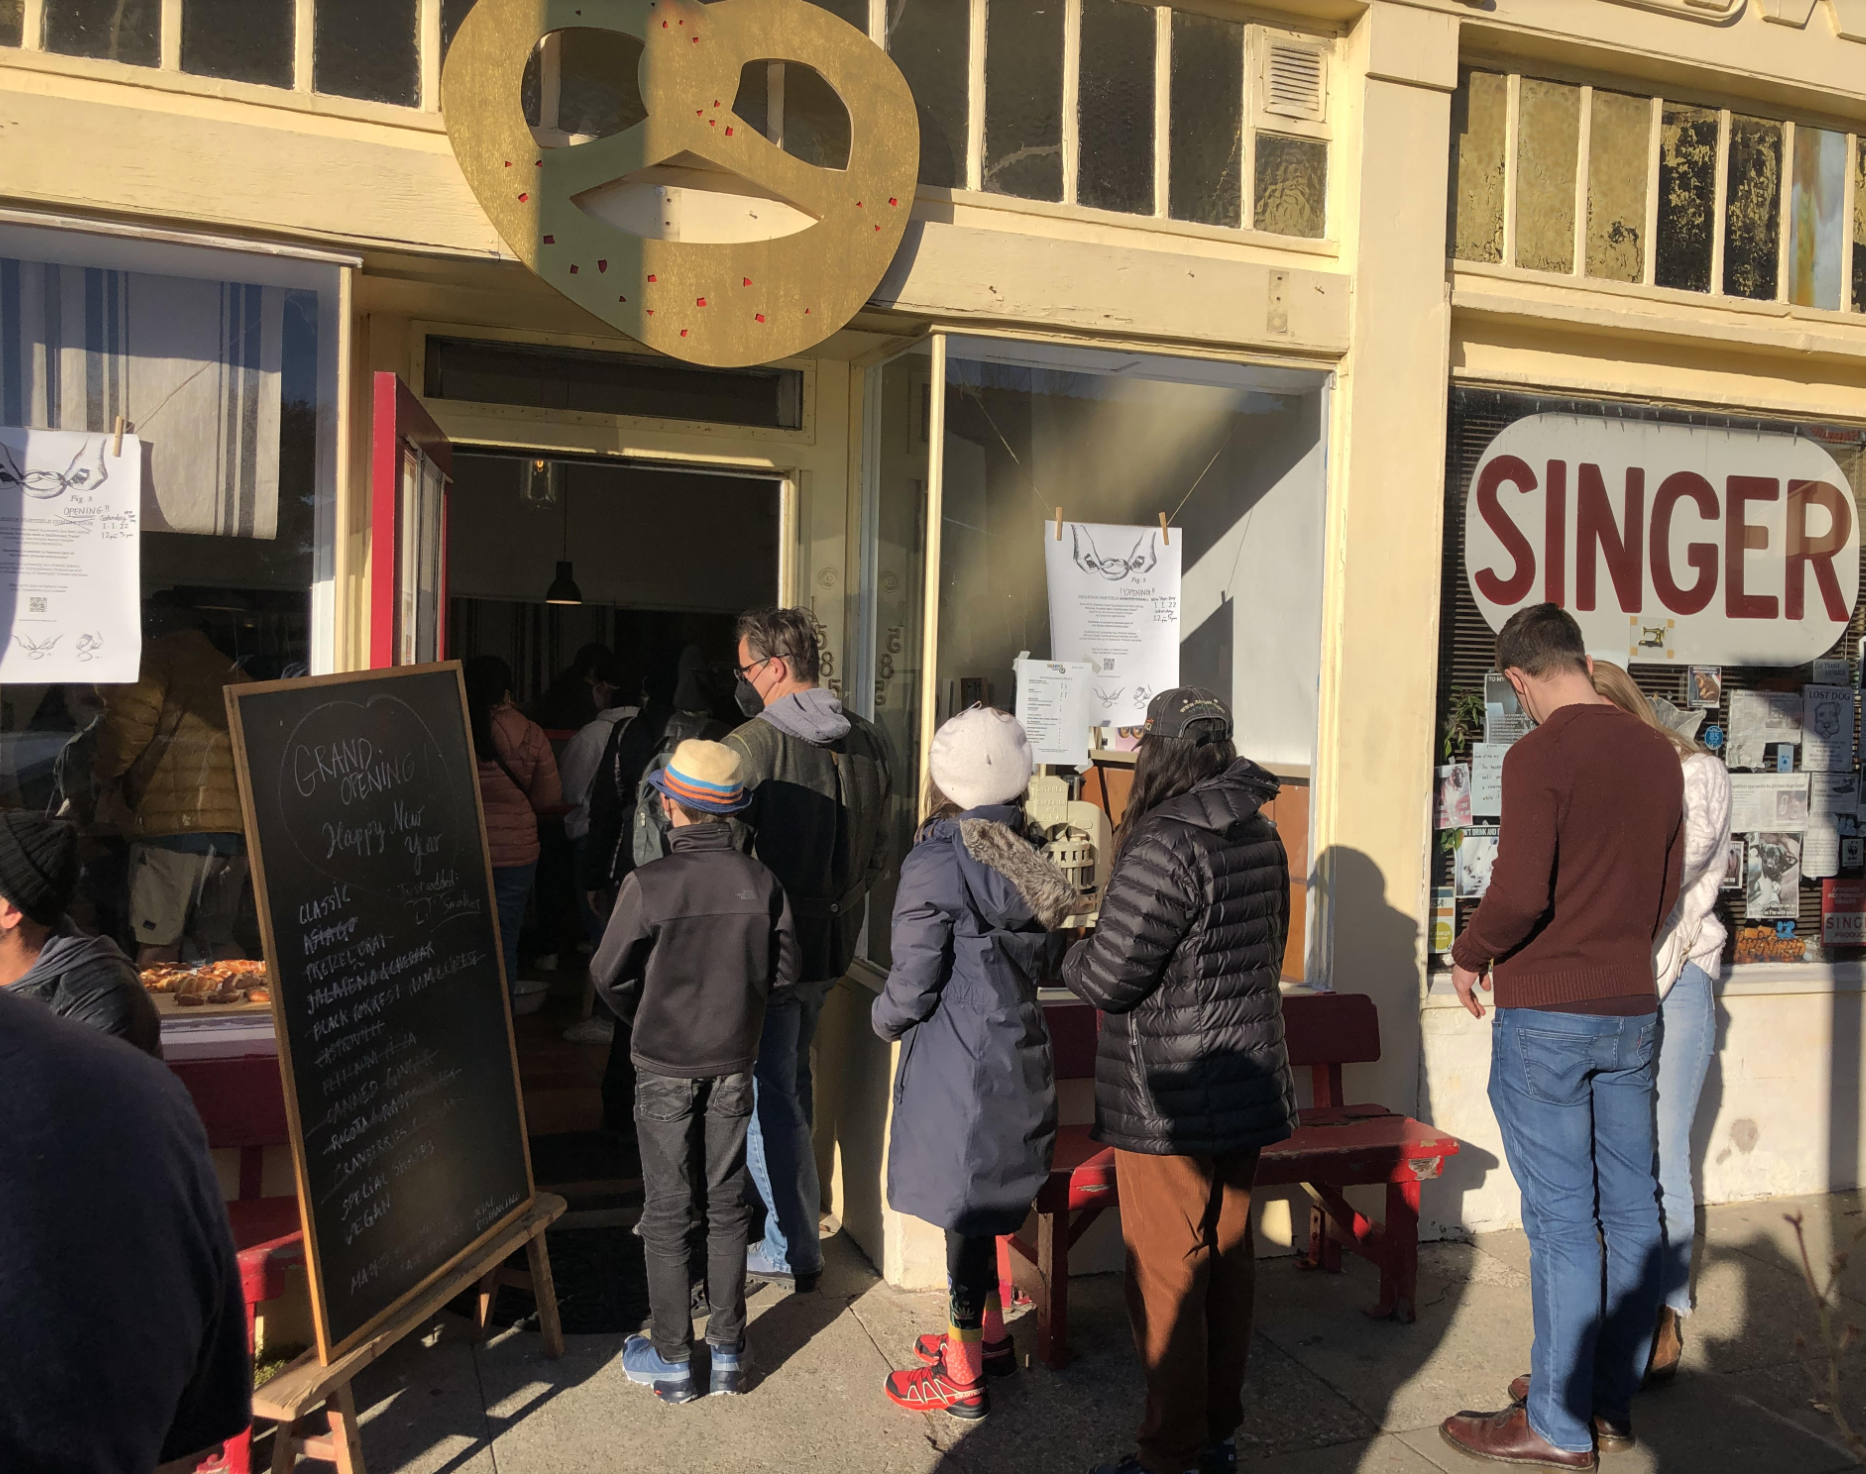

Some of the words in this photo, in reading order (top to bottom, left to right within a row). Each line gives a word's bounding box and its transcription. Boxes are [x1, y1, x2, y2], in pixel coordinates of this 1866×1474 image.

[1474, 453, 1852, 622] SINGER
[1809, 691, 1830, 699] LOST
[1831, 691, 1851, 700] DOG
[1709, 732, 1719, 741] 85
[294, 737, 373, 797] GRAND
[322, 820, 386, 859] Happy
[390, 800, 426, 835] New
[1471, 828, 1487, 836] DRINK
[1487, 828, 1497, 836] AND
[404, 832, 444, 875] Year
[299, 883, 351, 925] CLASSIC
[303, 916, 359, 955] ASIAGO
[306, 950, 356, 983] PRETZEL
[313, 1009, 349, 1042] BLACK
[340, 1172, 389, 1222] SPECIAL
[344, 1191, 391, 1246] VEGAN
